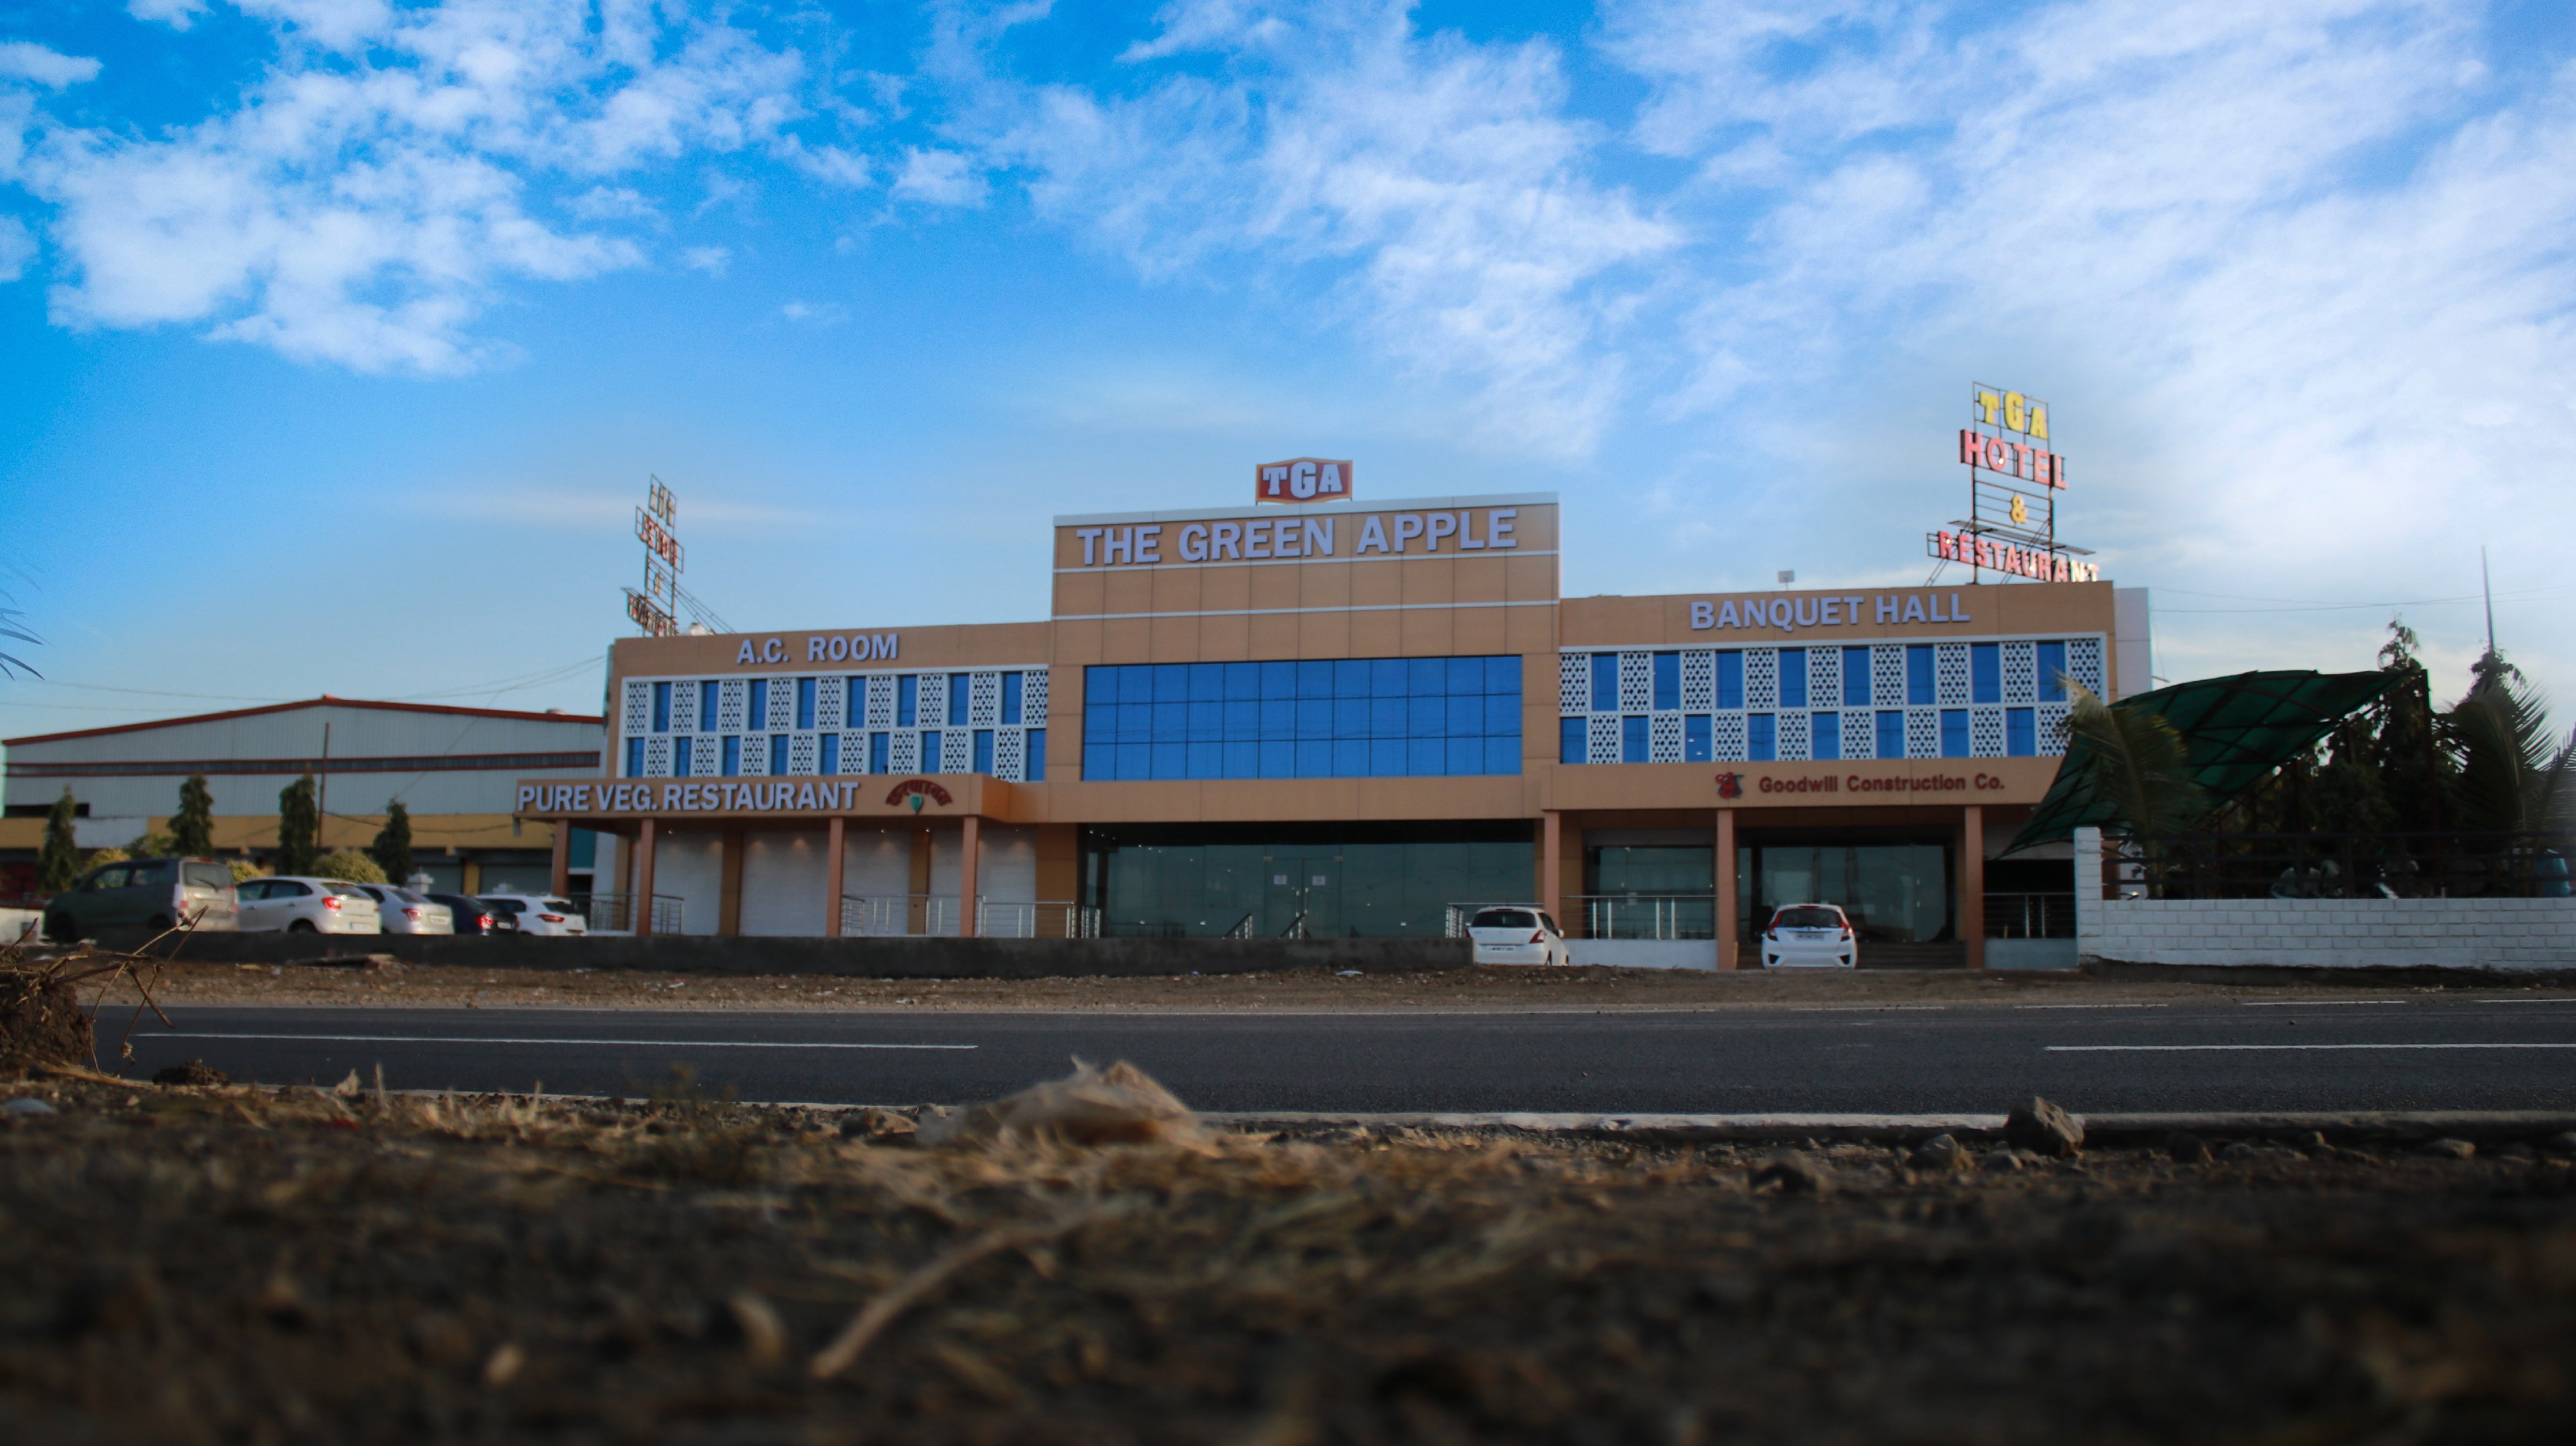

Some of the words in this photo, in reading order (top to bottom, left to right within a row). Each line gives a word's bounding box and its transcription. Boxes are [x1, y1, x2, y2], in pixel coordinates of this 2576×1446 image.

[1978, 391, 2048, 440] TGA
[1959, 429, 2069, 490] HOTEL
[1261, 460, 1343, 499] TGA
[2010, 494, 2028, 525] &
[1076, 525, 1163, 566] THE
[1178, 517, 1334, 563] GREEN
[1356, 509, 1518, 555] APPLE
[1937, 530, 2101, 582] RESTAURANT
[1690, 596, 1865, 632] BANQUET
[1875, 593, 1970, 625] HALL
[736, 637, 790, 664] A.C.
[807, 634, 898, 662] ROOM
[517, 784, 591, 813] PURE
[594, 783, 659, 812] VEG.
[662, 780, 860, 811] RESTAURANT
[1759, 775, 1839, 794] Goodwill
[1846, 774, 1966, 793] Construction
[1974, 772, 2005, 791] Co.
